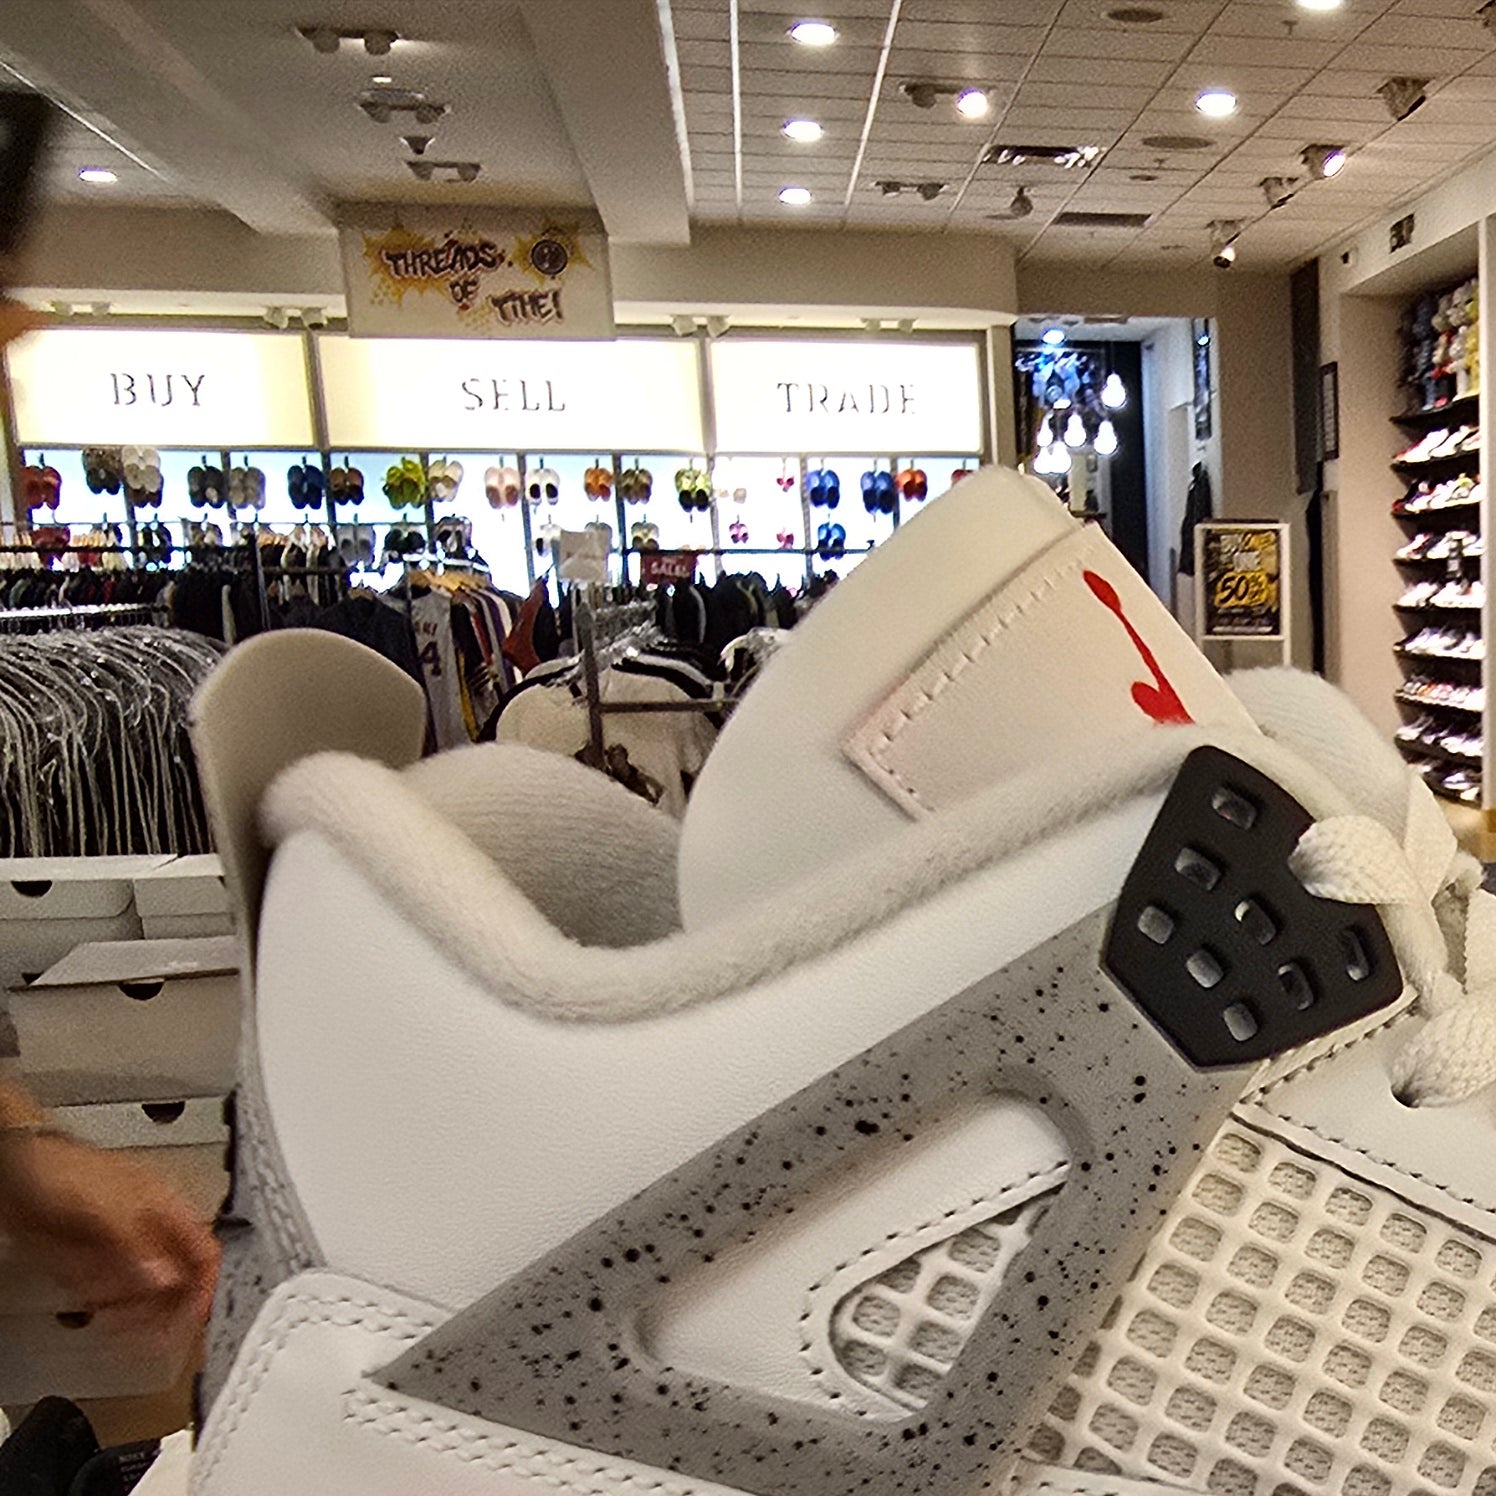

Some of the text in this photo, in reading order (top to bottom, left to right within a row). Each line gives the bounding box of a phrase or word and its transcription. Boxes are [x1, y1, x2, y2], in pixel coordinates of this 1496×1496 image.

[384, 241, 499, 277] THREADS
[110, 372, 205, 407] BUY
[461, 378, 565, 411] SELL
[777, 382, 915, 414] TRADE
